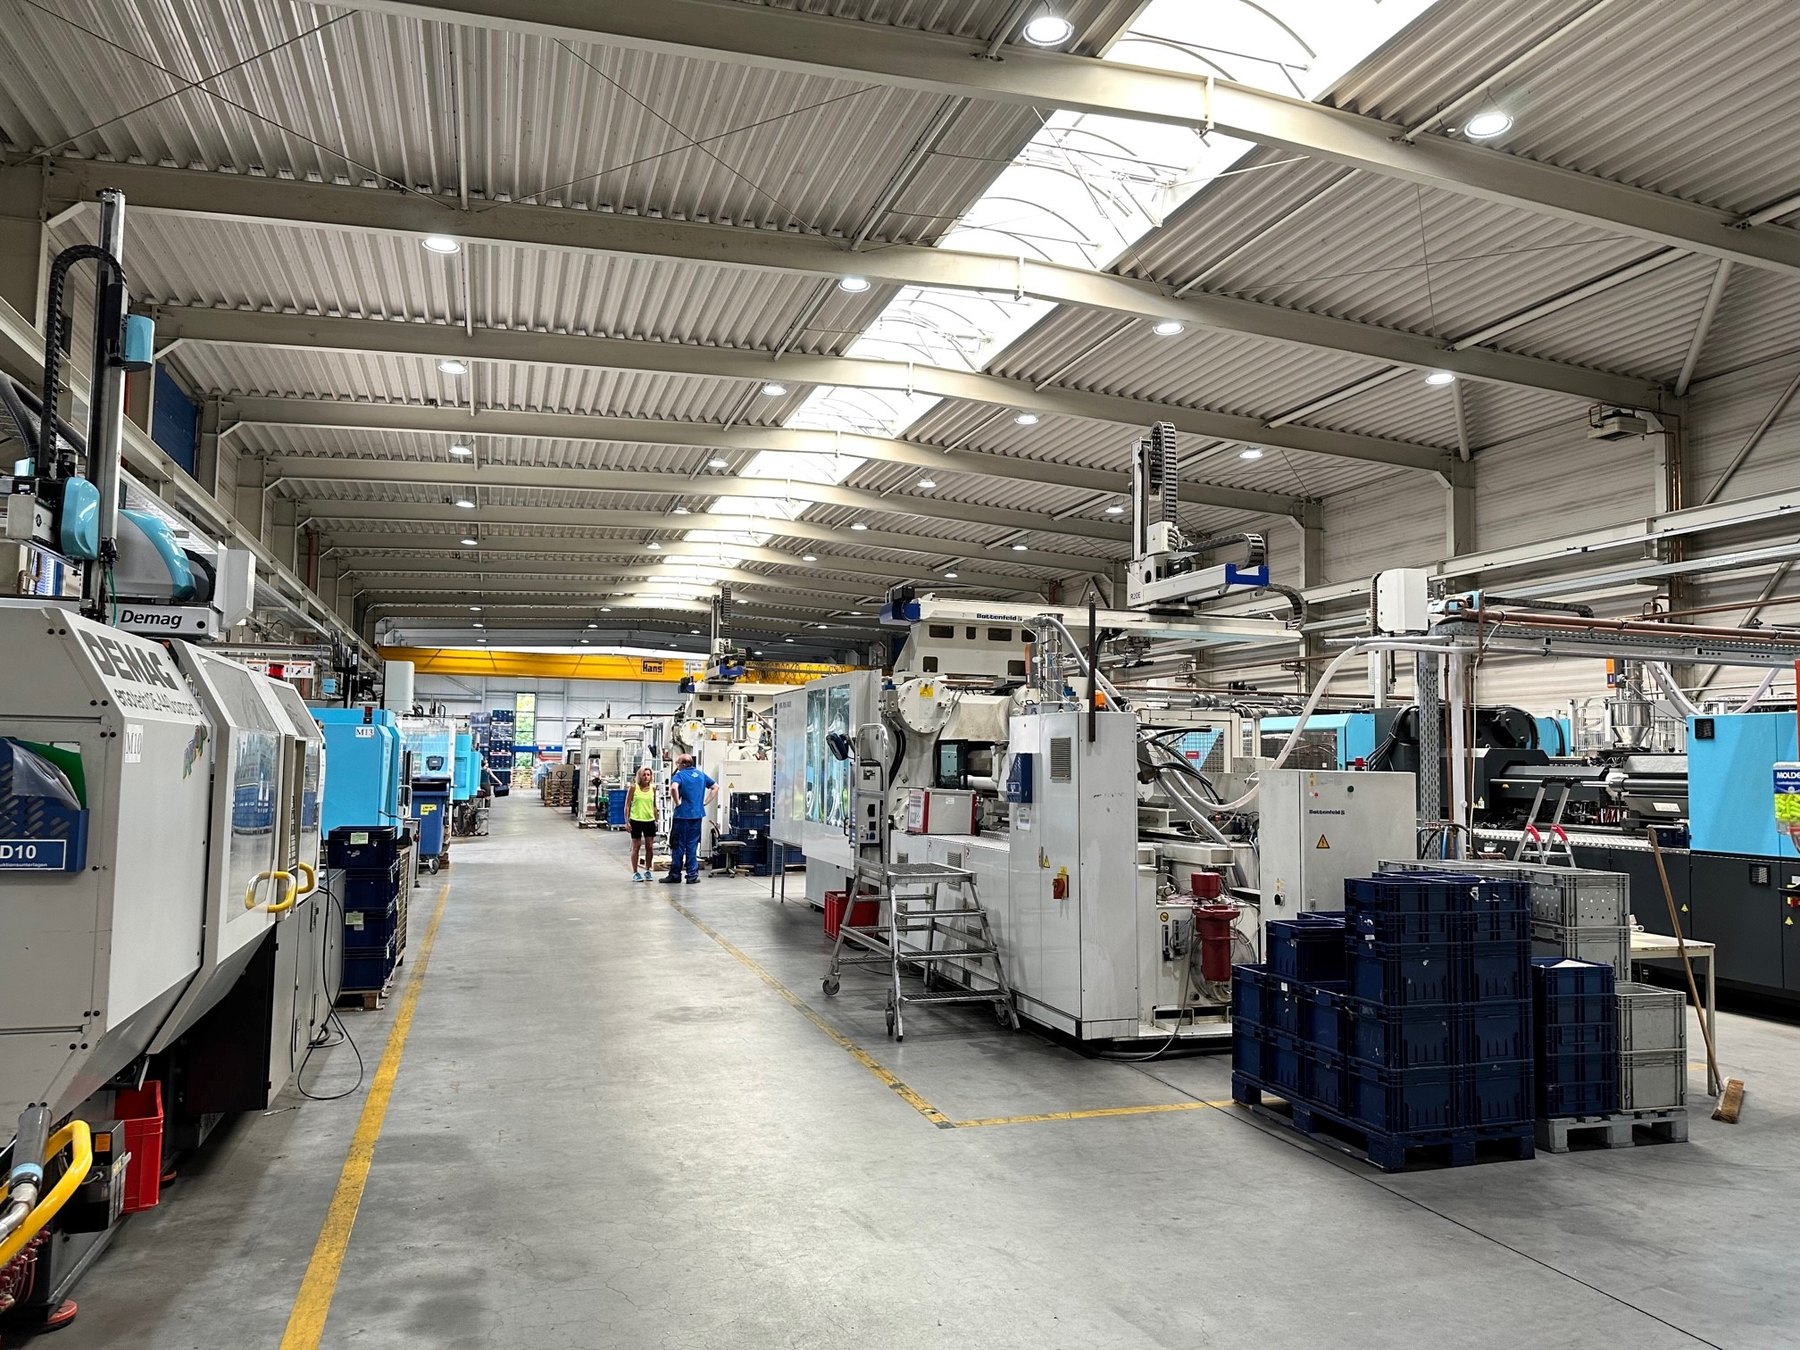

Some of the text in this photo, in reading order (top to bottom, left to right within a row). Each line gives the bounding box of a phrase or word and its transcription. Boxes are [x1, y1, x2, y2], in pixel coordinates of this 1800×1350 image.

[120, 609, 182, 629] Demag
[77, 628, 179, 691] DEMAG
[642, 660, 663, 673] Hans
[356, 728, 374, 736] M13
[125, 731, 142, 755] M10
